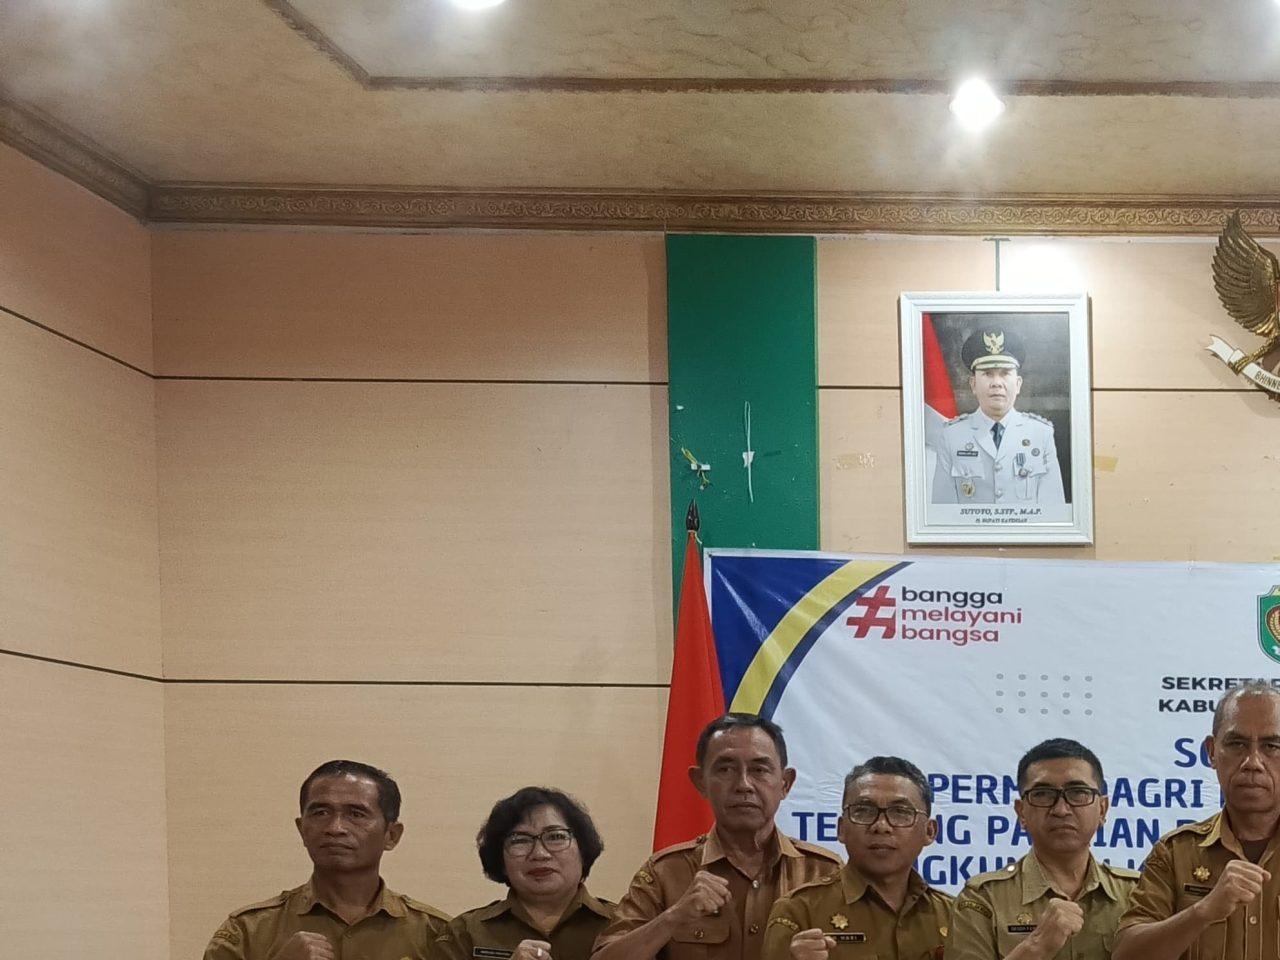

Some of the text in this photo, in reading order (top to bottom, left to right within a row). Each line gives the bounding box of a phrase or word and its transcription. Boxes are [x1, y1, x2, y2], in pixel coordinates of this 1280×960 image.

[901, 586, 1003, 609] bangga
[901, 606, 1022, 627] melayani
[901, 624, 999, 647] bangsa
[987, 815, 1160, 848] PAIAN
